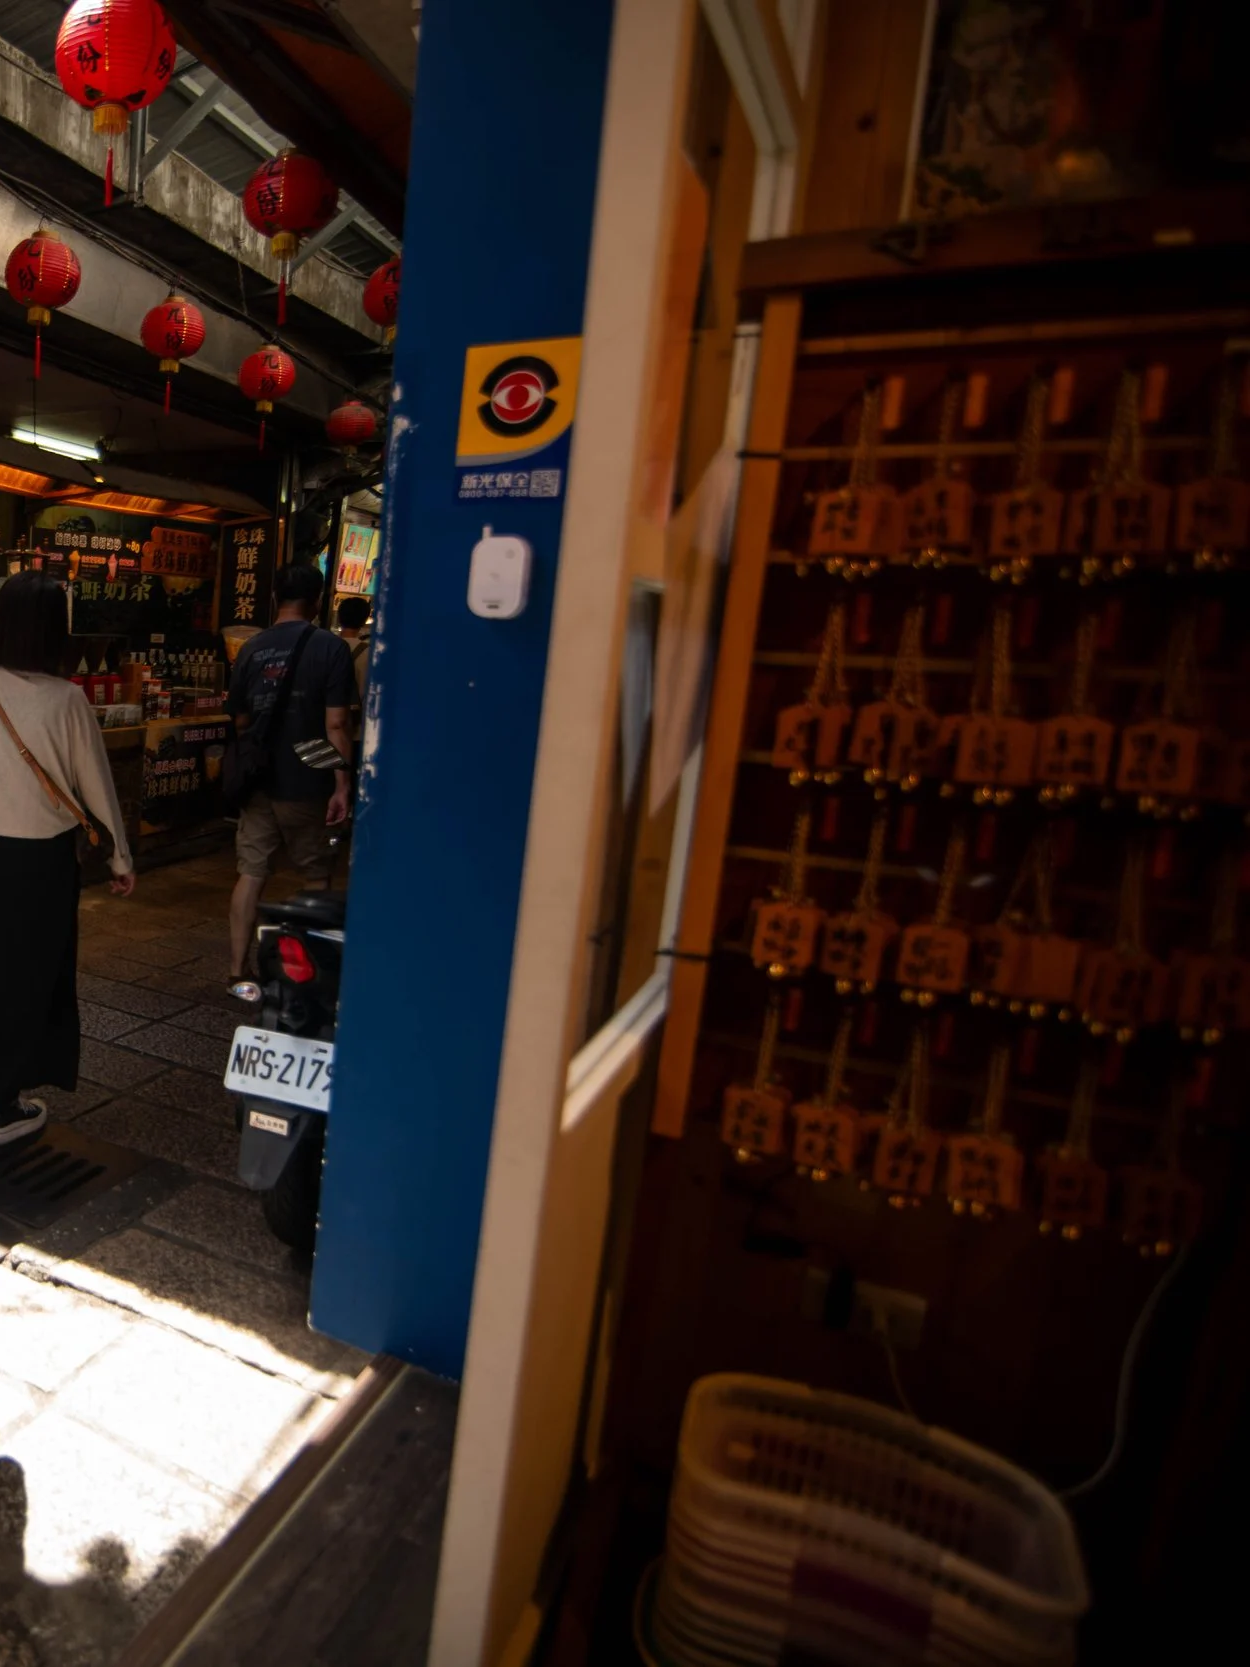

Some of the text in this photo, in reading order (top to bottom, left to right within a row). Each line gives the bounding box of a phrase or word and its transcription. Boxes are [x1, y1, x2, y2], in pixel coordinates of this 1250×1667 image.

[18, 239, 42, 293] 九份
[166, 305, 186, 351] 九份
[260, 354, 279, 395] 九份
[460, 471, 530, 490] 新光保全
[232, 545, 259, 620] 鮮奶茶
